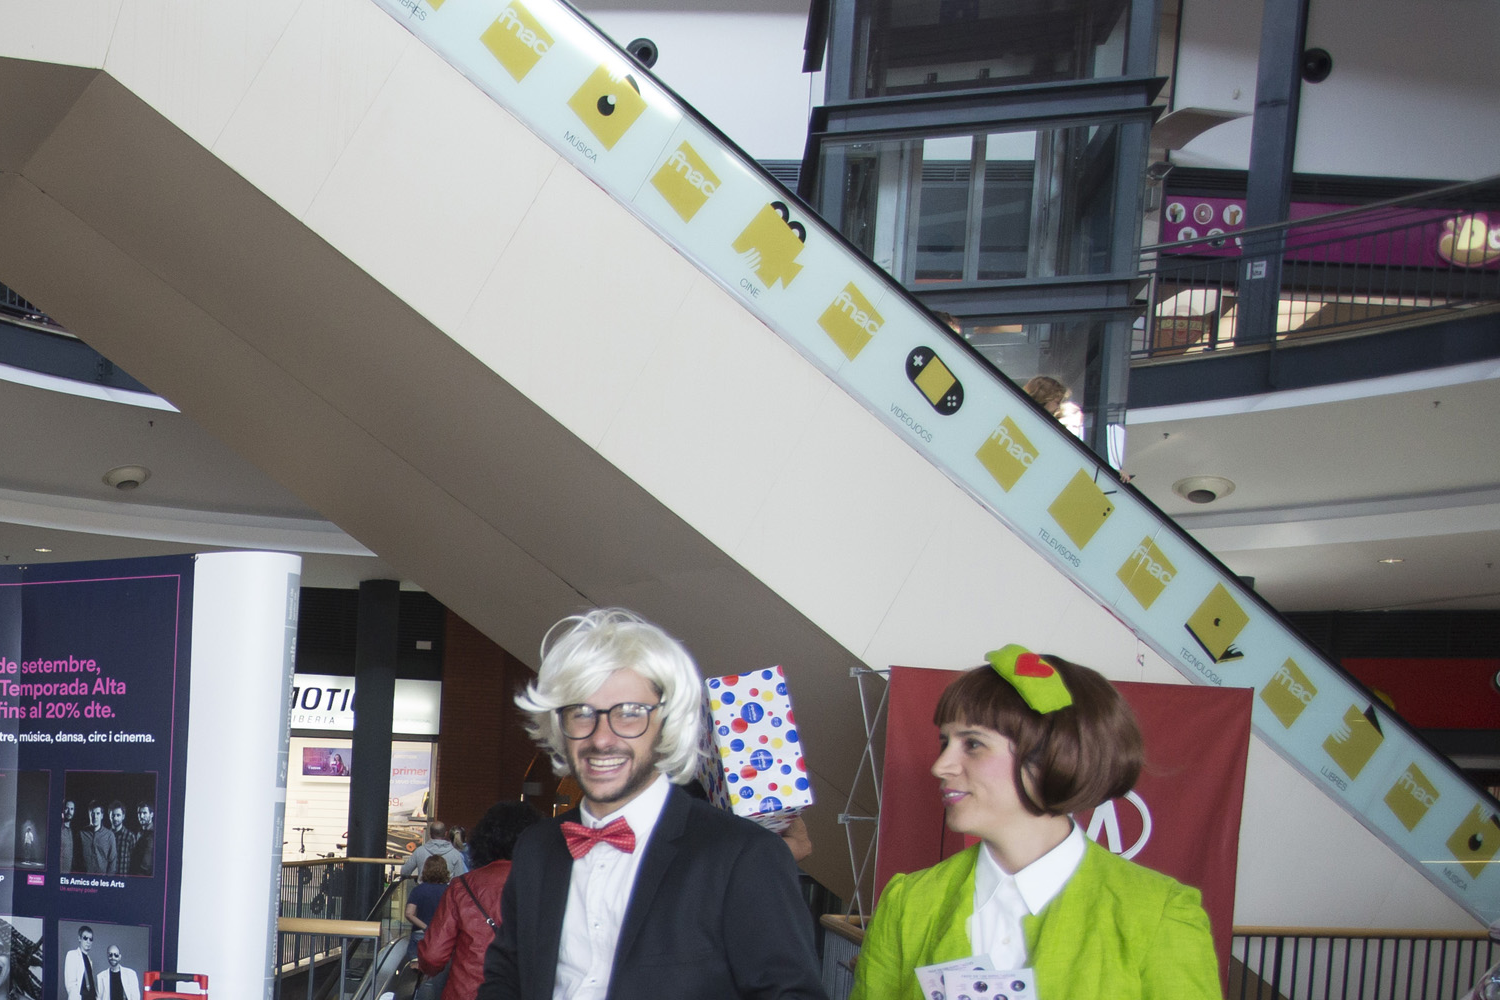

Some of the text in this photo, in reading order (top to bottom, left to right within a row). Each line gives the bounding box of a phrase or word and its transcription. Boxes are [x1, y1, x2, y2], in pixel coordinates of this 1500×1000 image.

[499, 7, 549, 57] fnac
[563, 130, 598, 164] MÚSICA
[668, 151, 717, 198] fnac
[739, 277, 761, 299] CINE
[833, 291, 879, 336] fnac
[890, 402, 933, 444] VIDEOJOCS
[990, 425, 1034, 468] fnac
[1037, 527, 1082, 568] TELEVISORS
[1131, 544, 1174, 585] fnac
[21, 655, 101, 676] setembre,
[1179, 647, 1223, 686] TECNOLOGIA
[0, 678, 88, 700] Temporada
[92, 677, 127, 695] Alta
[292, 686, 356, 712] OTI
[1274, 667, 1314, 705] fnac
[29, 701, 42, 719] al
[45, 702, 80, 719] 20%
[84, 700, 116, 718] dte.
[19, 730, 54, 744] música,
[55, 730, 86, 744] dansa,
[88, 730, 108, 742] circ
[108, 730, 112, 742] i
[114, 730, 155, 743] cinema.
[392, 766, 428, 777] primer
[1320, 766, 1348, 792] LLIBRES
[1398, 771, 1437, 808] fnac
[60, 877, 70, 885] Els
[70, 878, 90, 886] Amics
[100, 879, 110, 887] les
[110, 880, 125, 888] Arts
